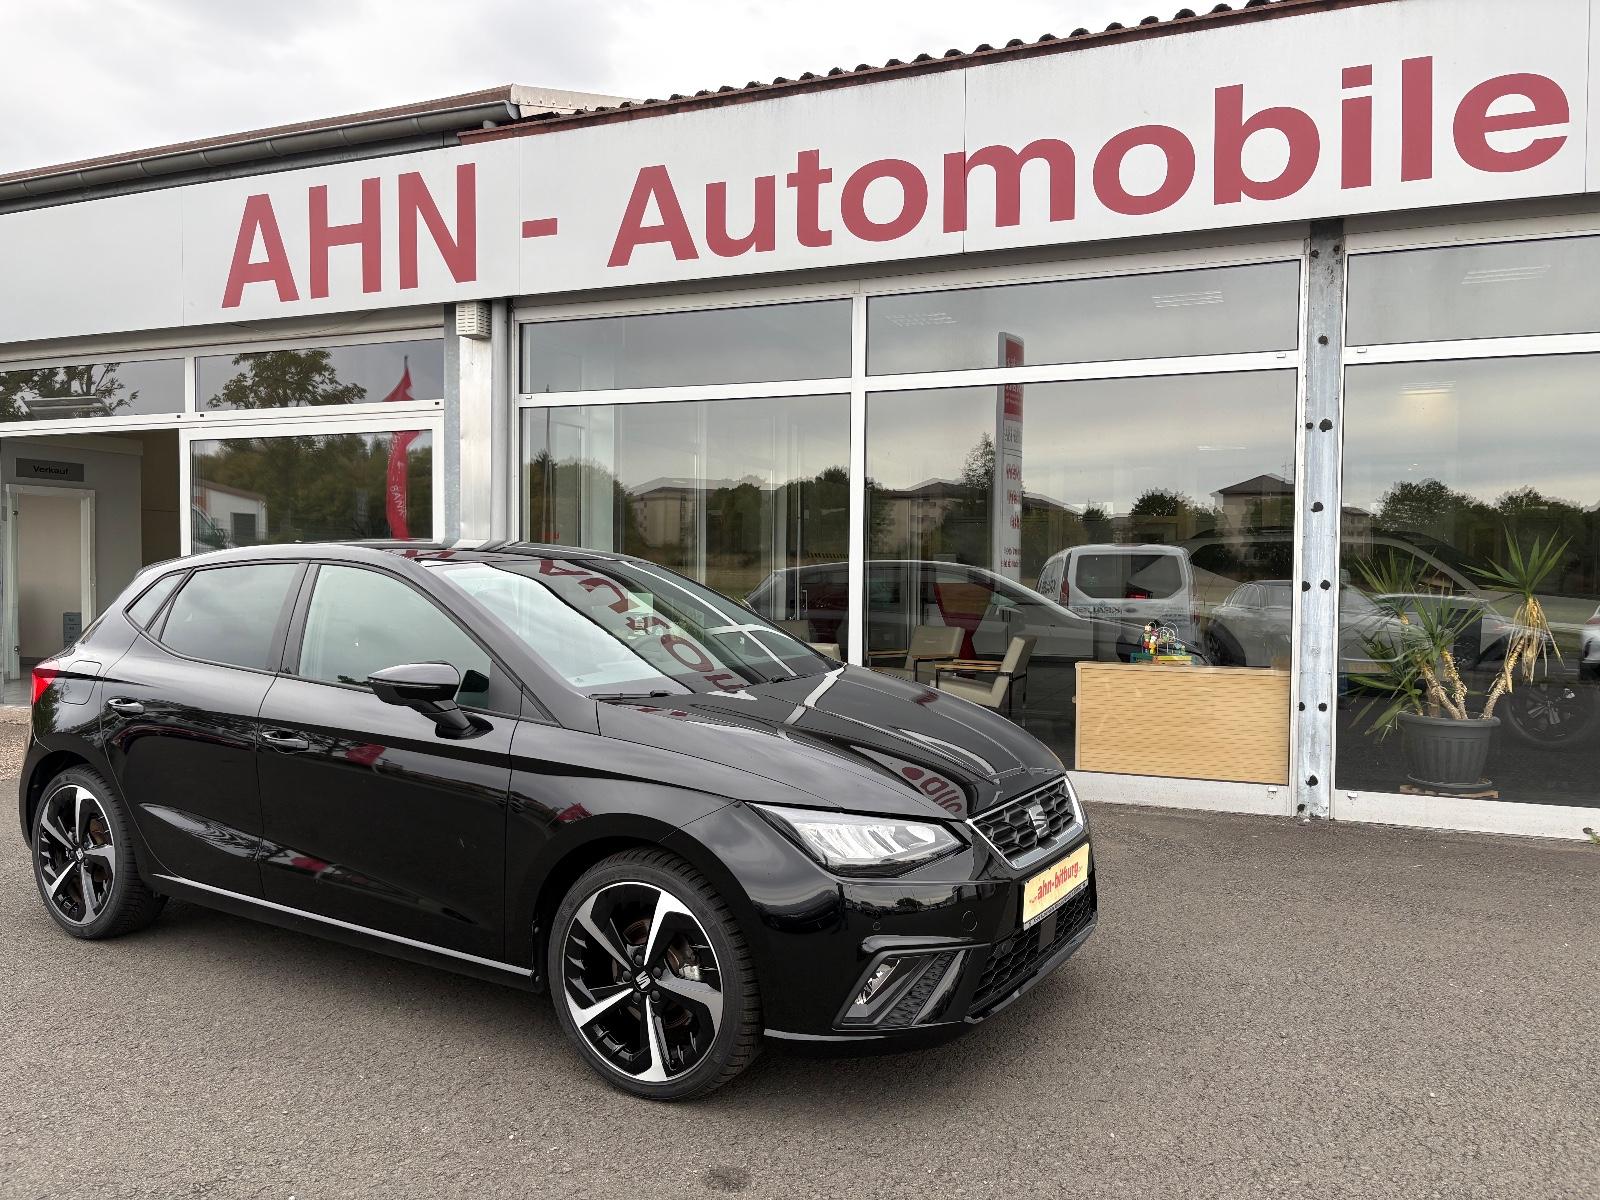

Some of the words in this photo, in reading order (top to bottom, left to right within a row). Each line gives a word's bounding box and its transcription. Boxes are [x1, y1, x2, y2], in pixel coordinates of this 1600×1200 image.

[223, 163, 477, 309] AHN
[608, 56, 1569, 267] Automobile
[32, 464, 69, 475] Verkauf
